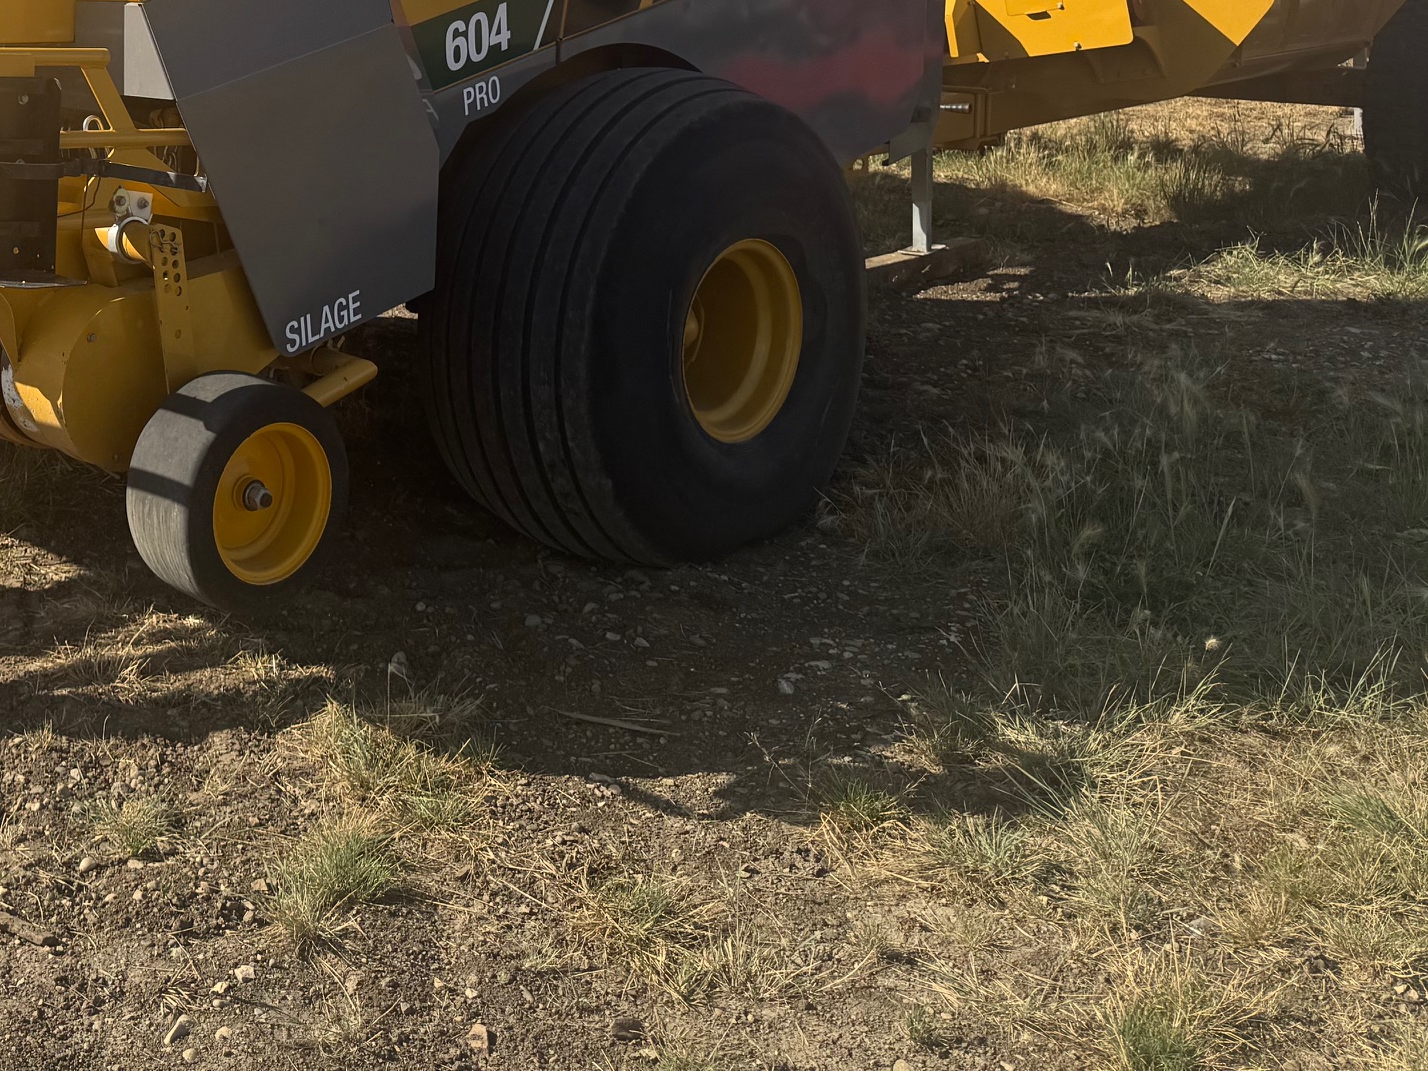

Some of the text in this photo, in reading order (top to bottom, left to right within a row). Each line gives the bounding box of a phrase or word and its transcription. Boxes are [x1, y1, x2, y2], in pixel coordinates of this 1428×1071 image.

[445, 2, 511, 72] 604
[463, 75, 501, 116] PRO
[285, 289, 362, 353] SILAGE
